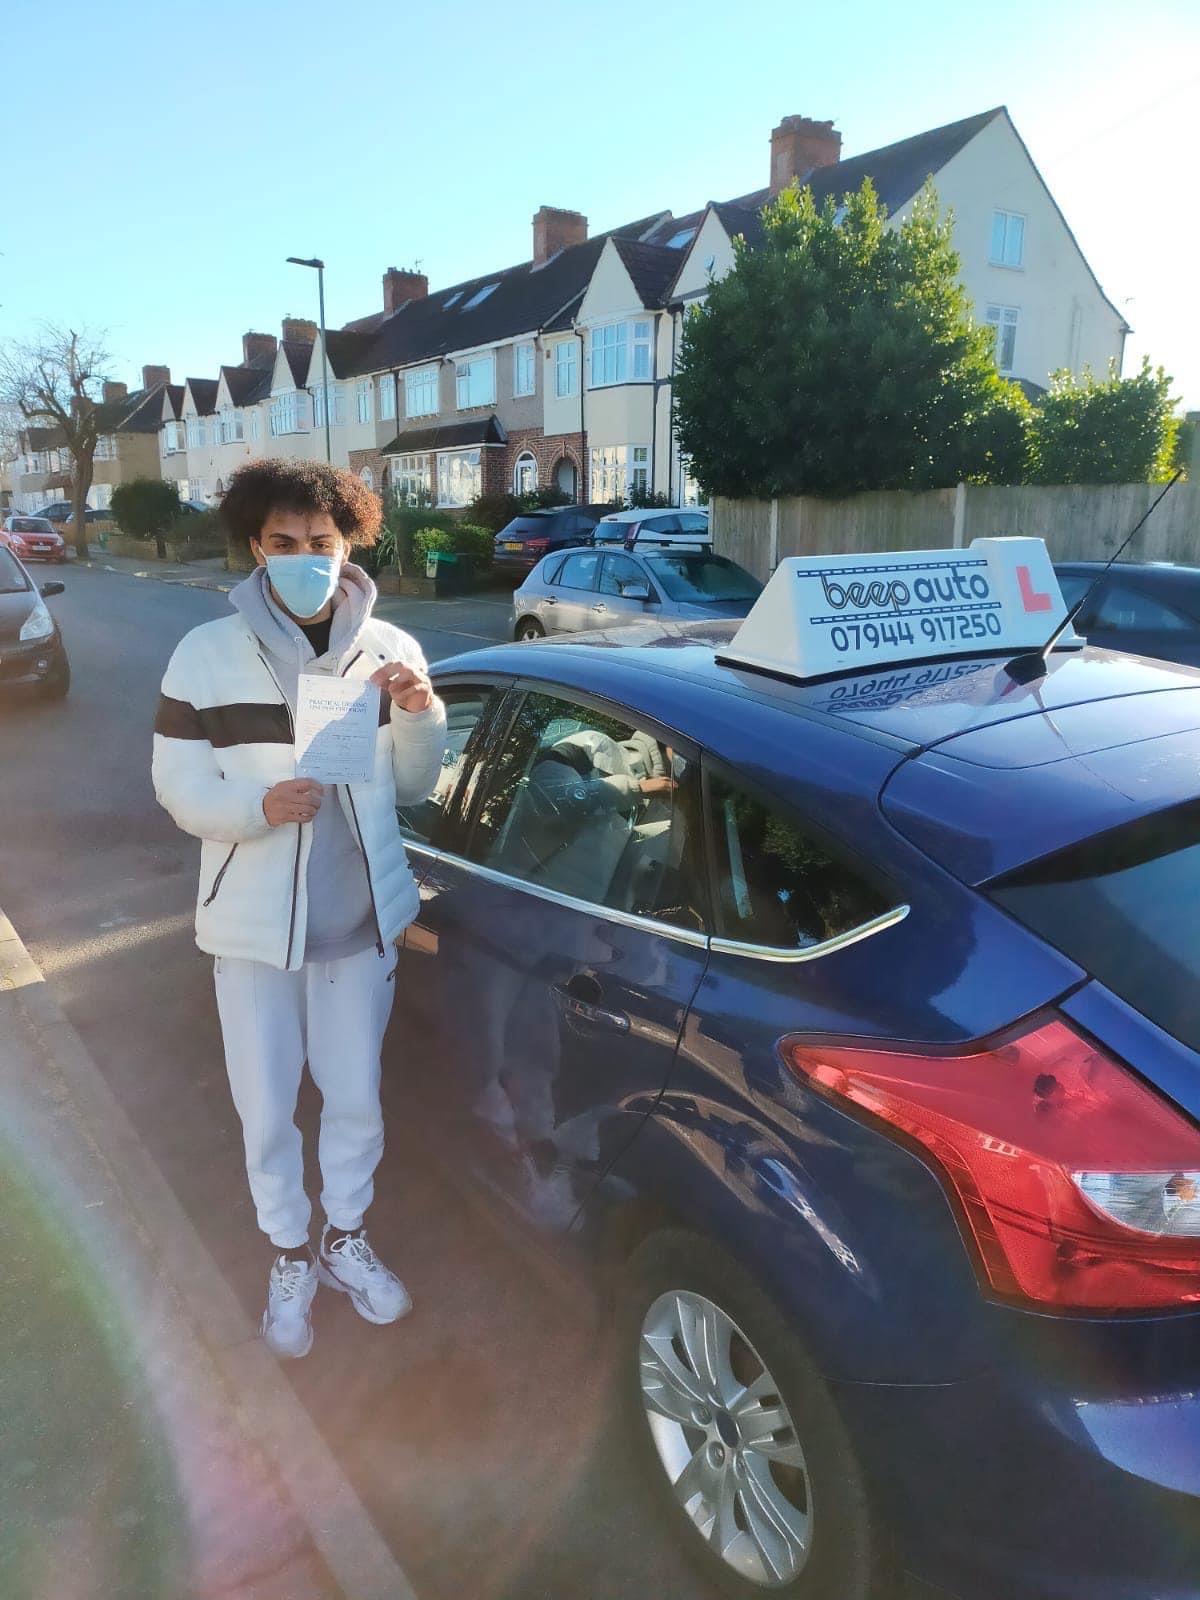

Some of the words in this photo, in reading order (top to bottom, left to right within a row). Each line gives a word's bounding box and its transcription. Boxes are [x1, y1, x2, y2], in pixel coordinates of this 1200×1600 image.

[821, 575, 911, 611] beep
[914, 566, 989, 603] auto
[1015, 565, 1053, 614] L
[830, 621, 914, 652] 07944
[921, 613, 1002, 642] 917250
